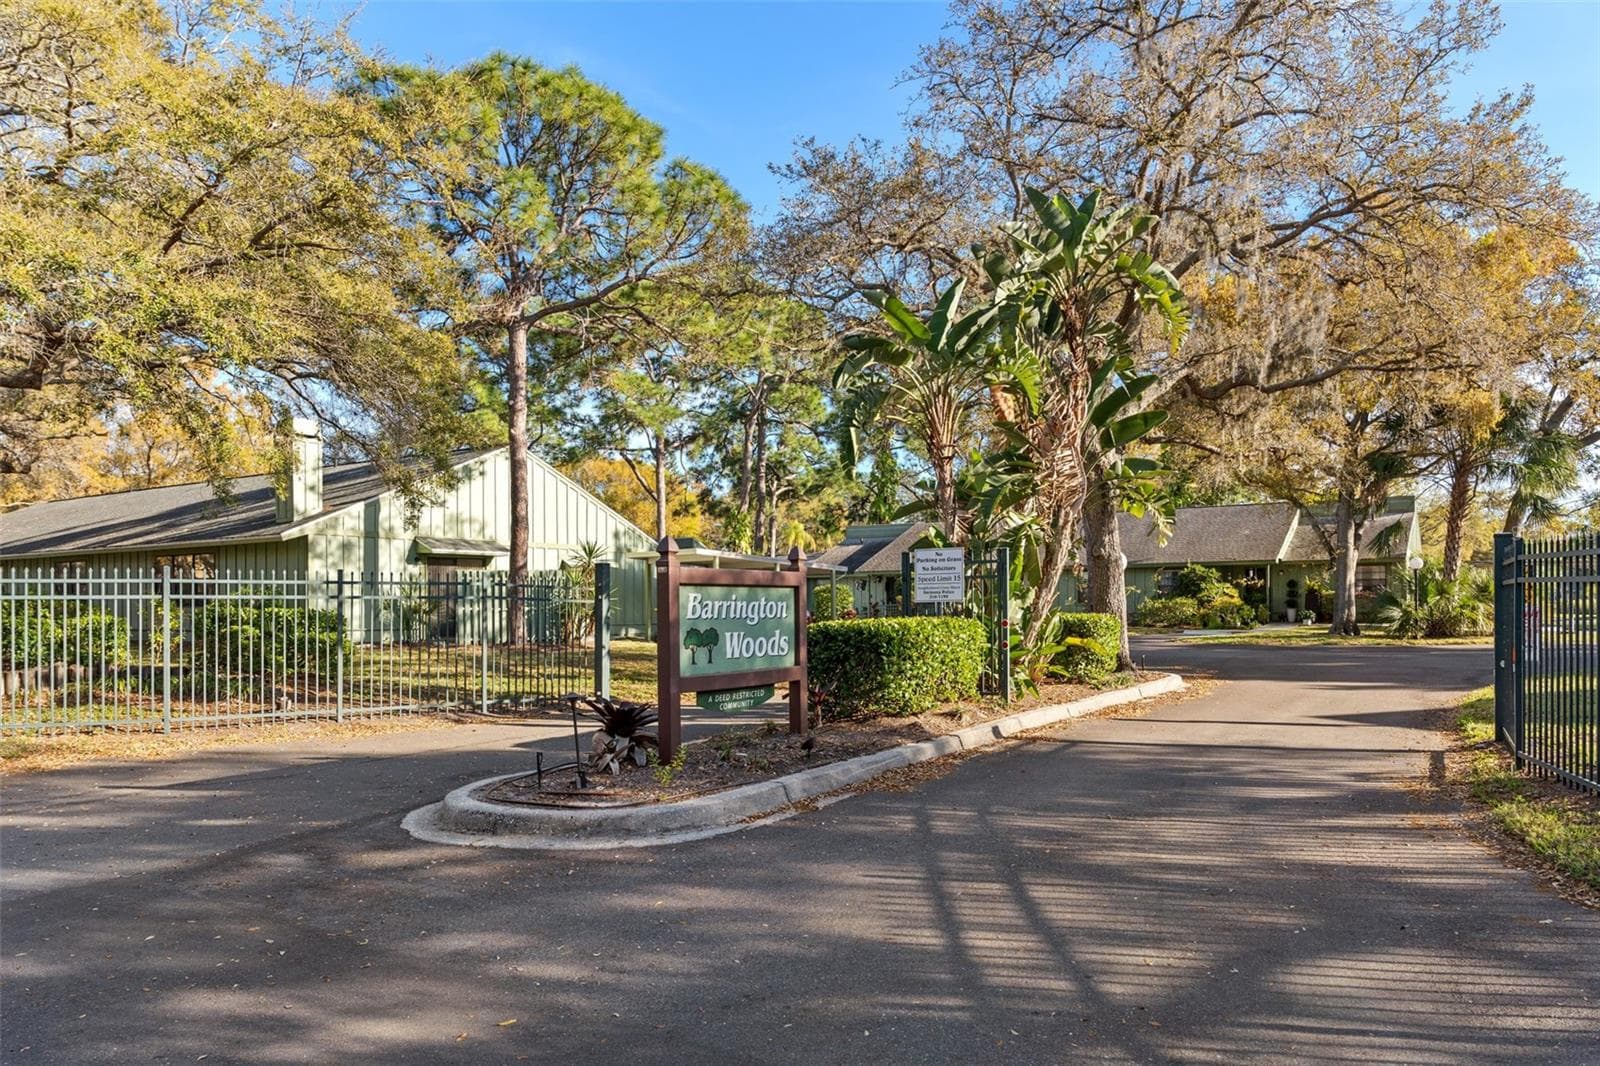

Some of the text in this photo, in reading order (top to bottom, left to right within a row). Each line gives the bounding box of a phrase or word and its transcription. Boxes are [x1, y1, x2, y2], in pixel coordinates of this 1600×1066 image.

[918, 575, 936, 583] Speed
[953, 574, 961, 582] 15
[686, 592, 787, 625] Barrington
[725, 630, 789, 659] Woods
[708, 689, 765, 703] A DEED RESTRICTED
[719, 699, 754, 711] COMMUNITY
